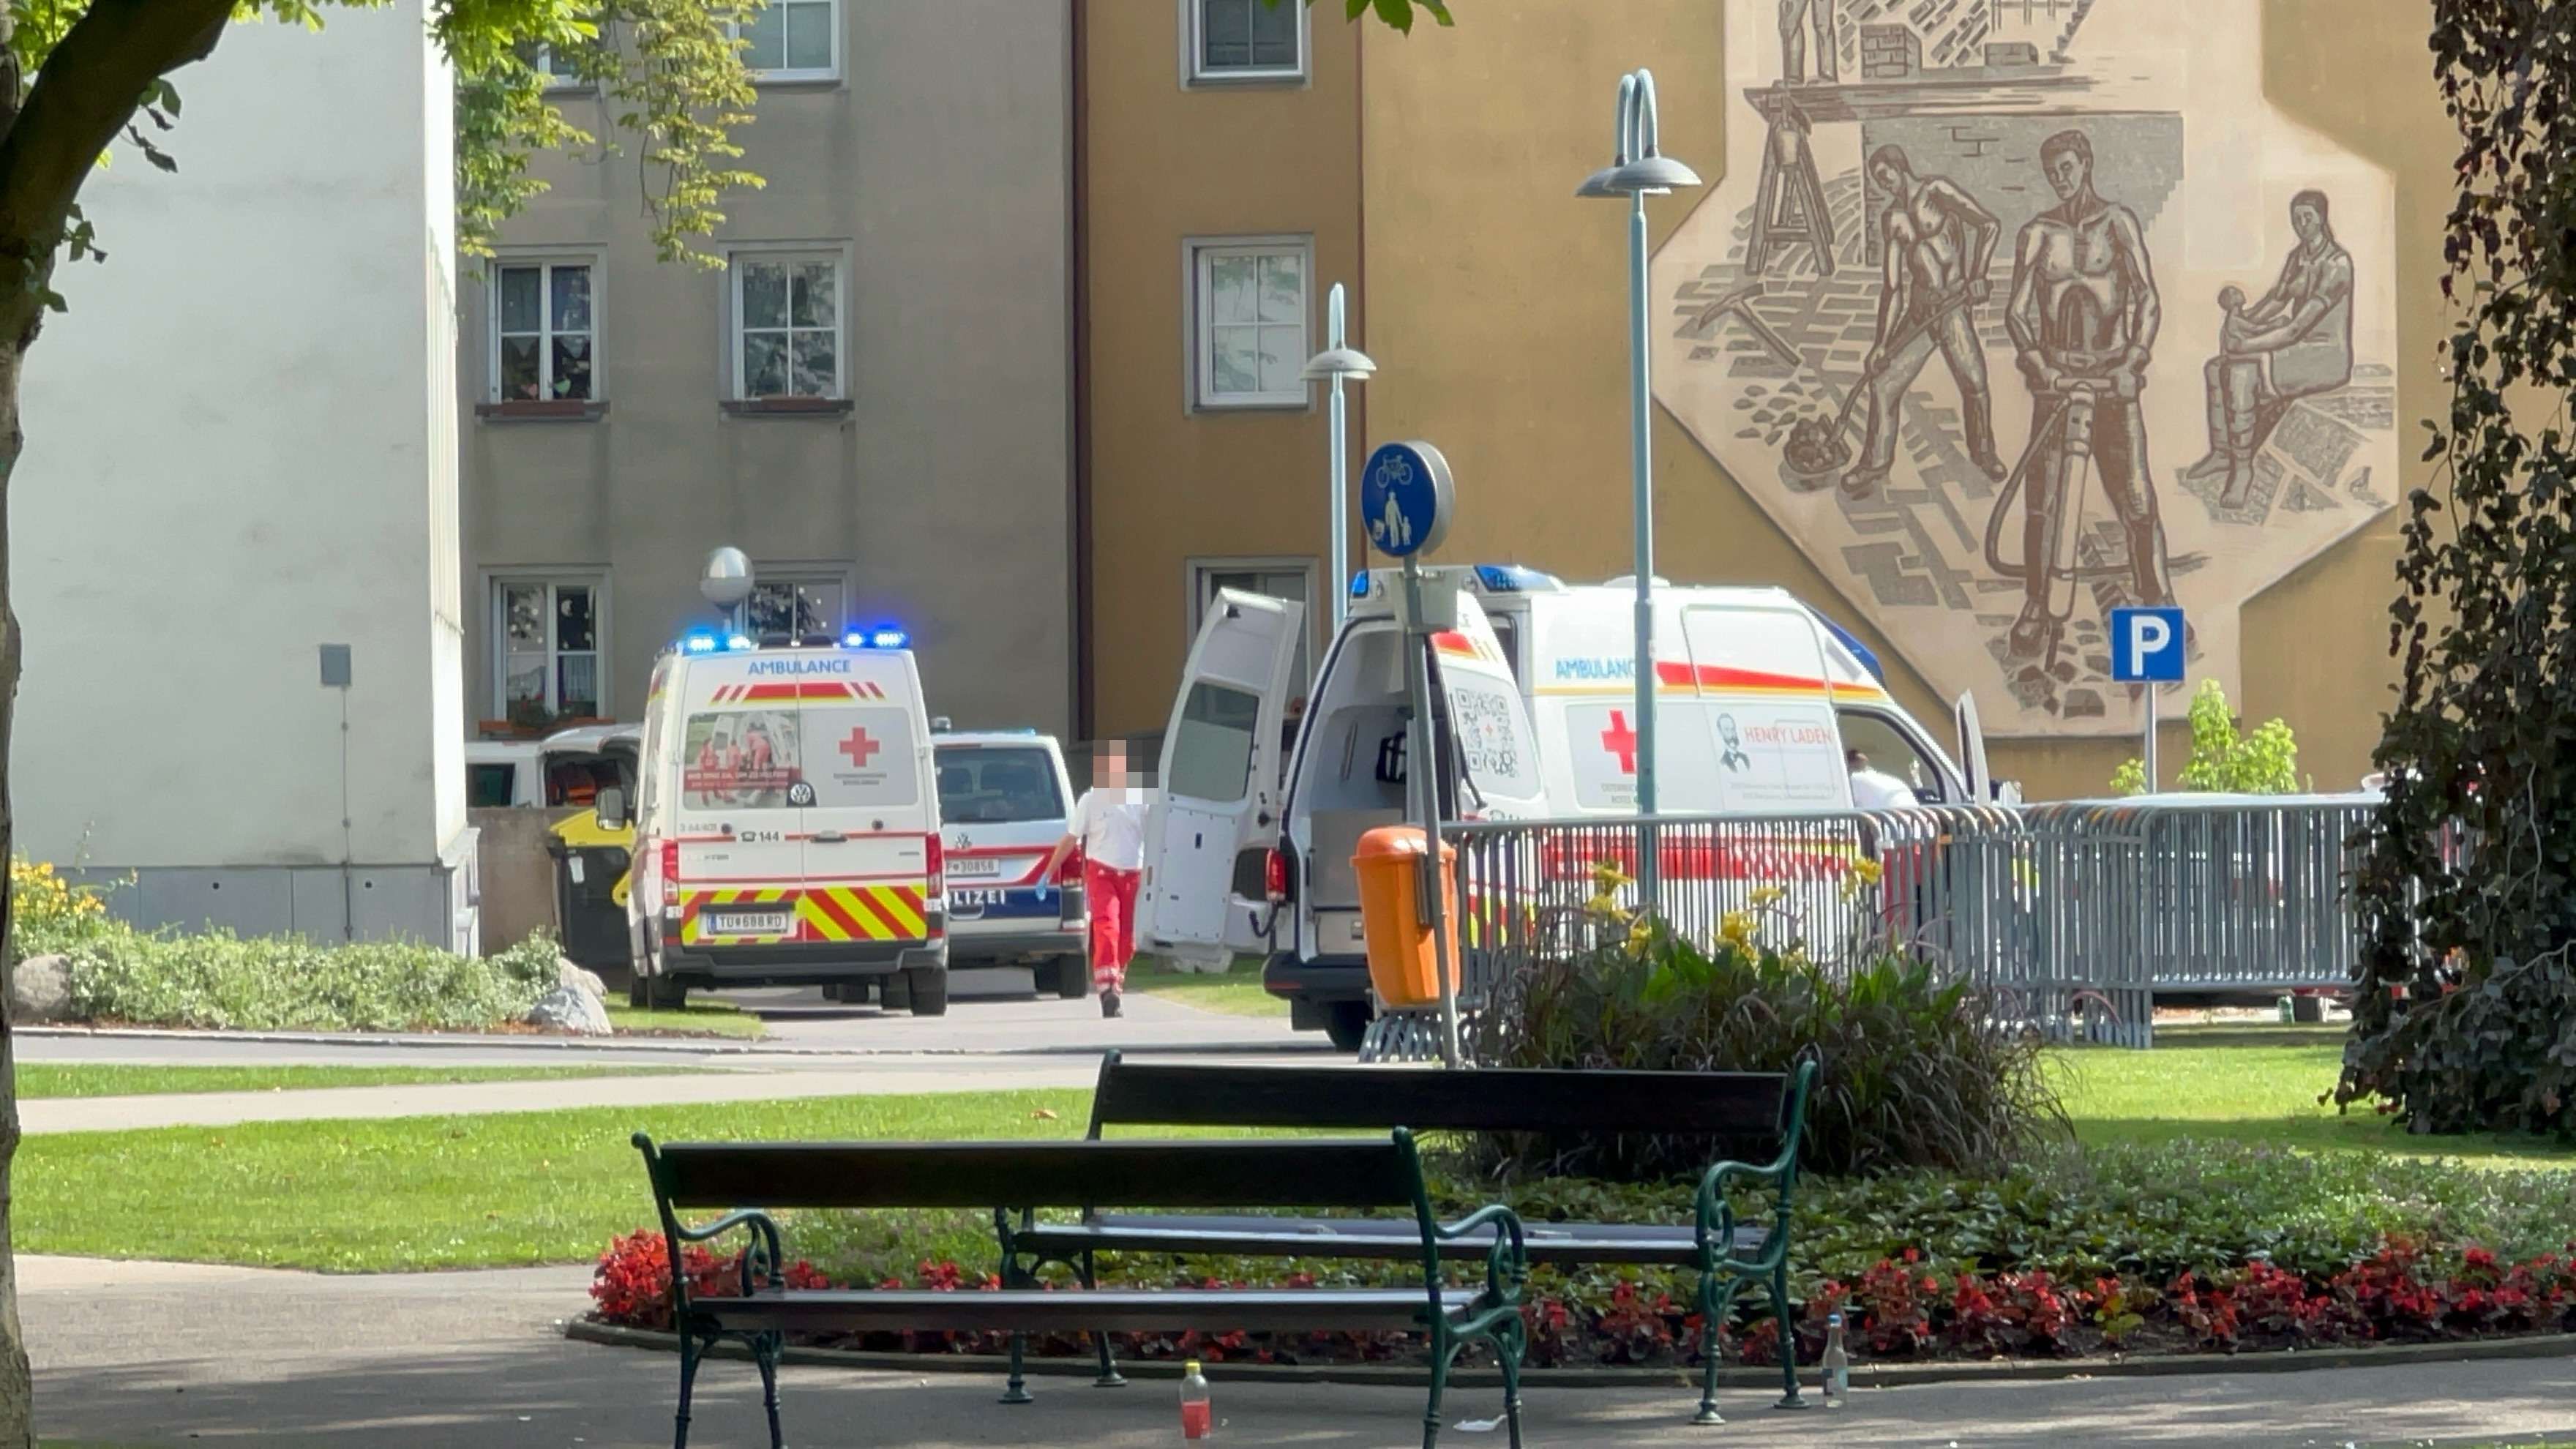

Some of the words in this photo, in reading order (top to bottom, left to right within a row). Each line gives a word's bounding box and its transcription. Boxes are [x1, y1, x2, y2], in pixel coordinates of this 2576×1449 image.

[2131, 615, 2171, 676] P
[748, 660, 851, 675] AMBULANCE
[1556, 658, 1636, 679] AMBULANC
[1744, 727, 1787, 744] HENRY
[760, 831, 779, 842] 144
[949, 889, 1006, 905] LIZEI
